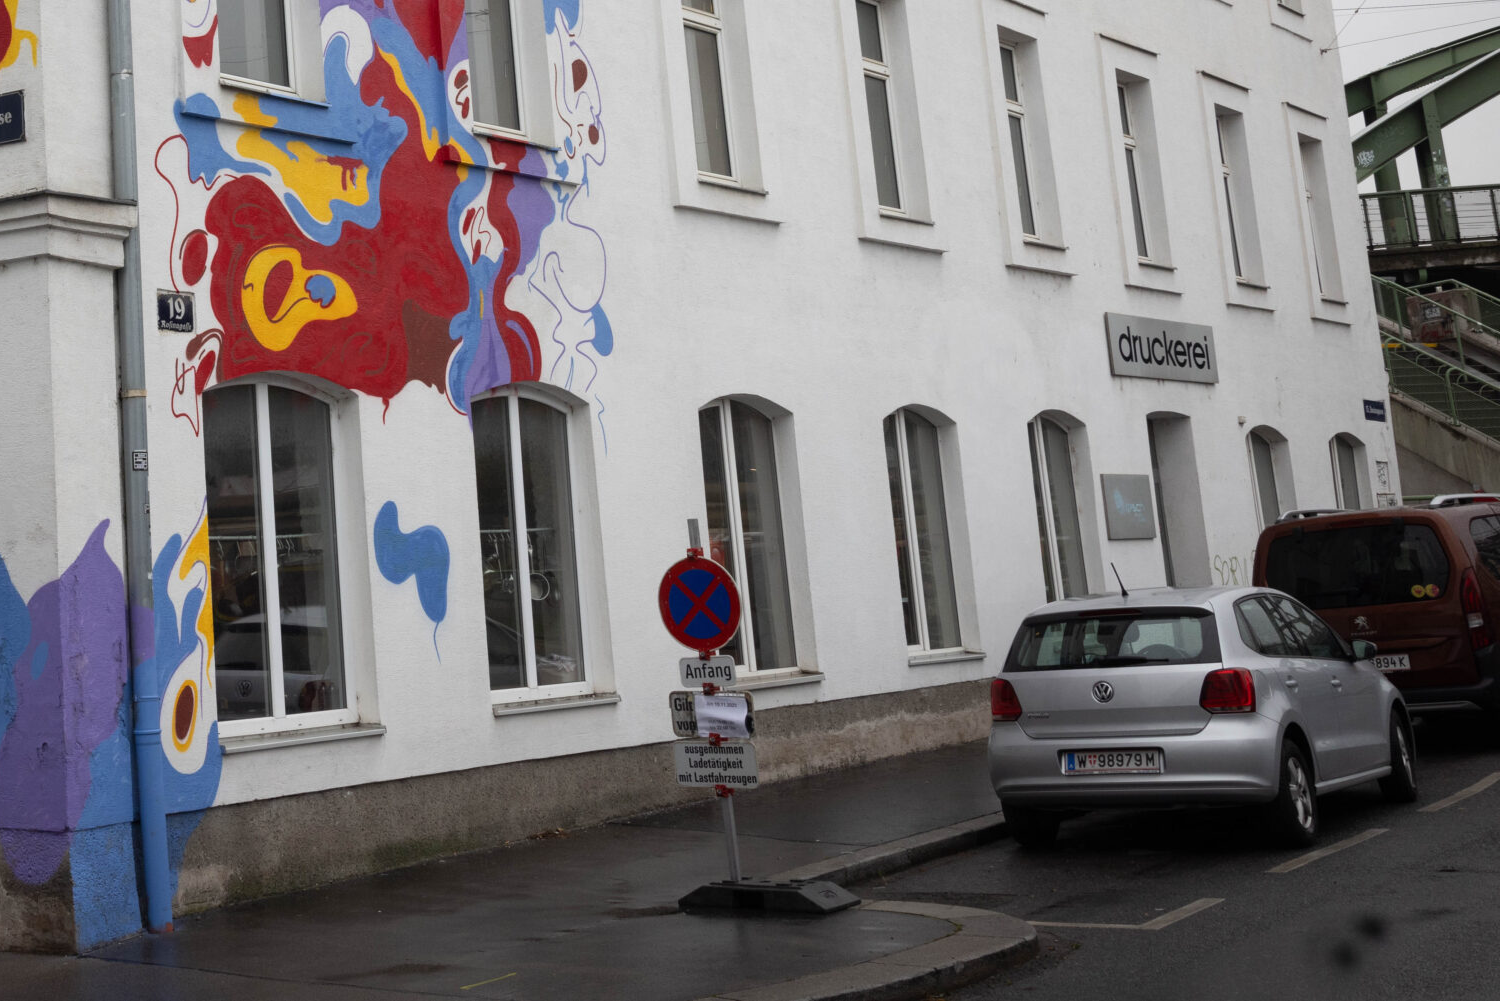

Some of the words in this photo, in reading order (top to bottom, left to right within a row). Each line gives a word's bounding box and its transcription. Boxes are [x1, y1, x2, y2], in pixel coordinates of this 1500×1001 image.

[167, 297, 186, 320] 19
[1118, 326, 1211, 370] druckerei
[1398, 656, 1406, 667] K
[686, 663, 732, 681] Anfang
[684, 745, 744, 756] ausgenommen
[688, 757, 743, 771] Ladetätigkeit
[1077, 755, 1086, 767] W
[1098, 753, 1142, 767] 98979
[1146, 753, 1154, 766] M
[678, 771, 692, 783] mit
[694, 771, 757, 786] Lastfahrzeugen
